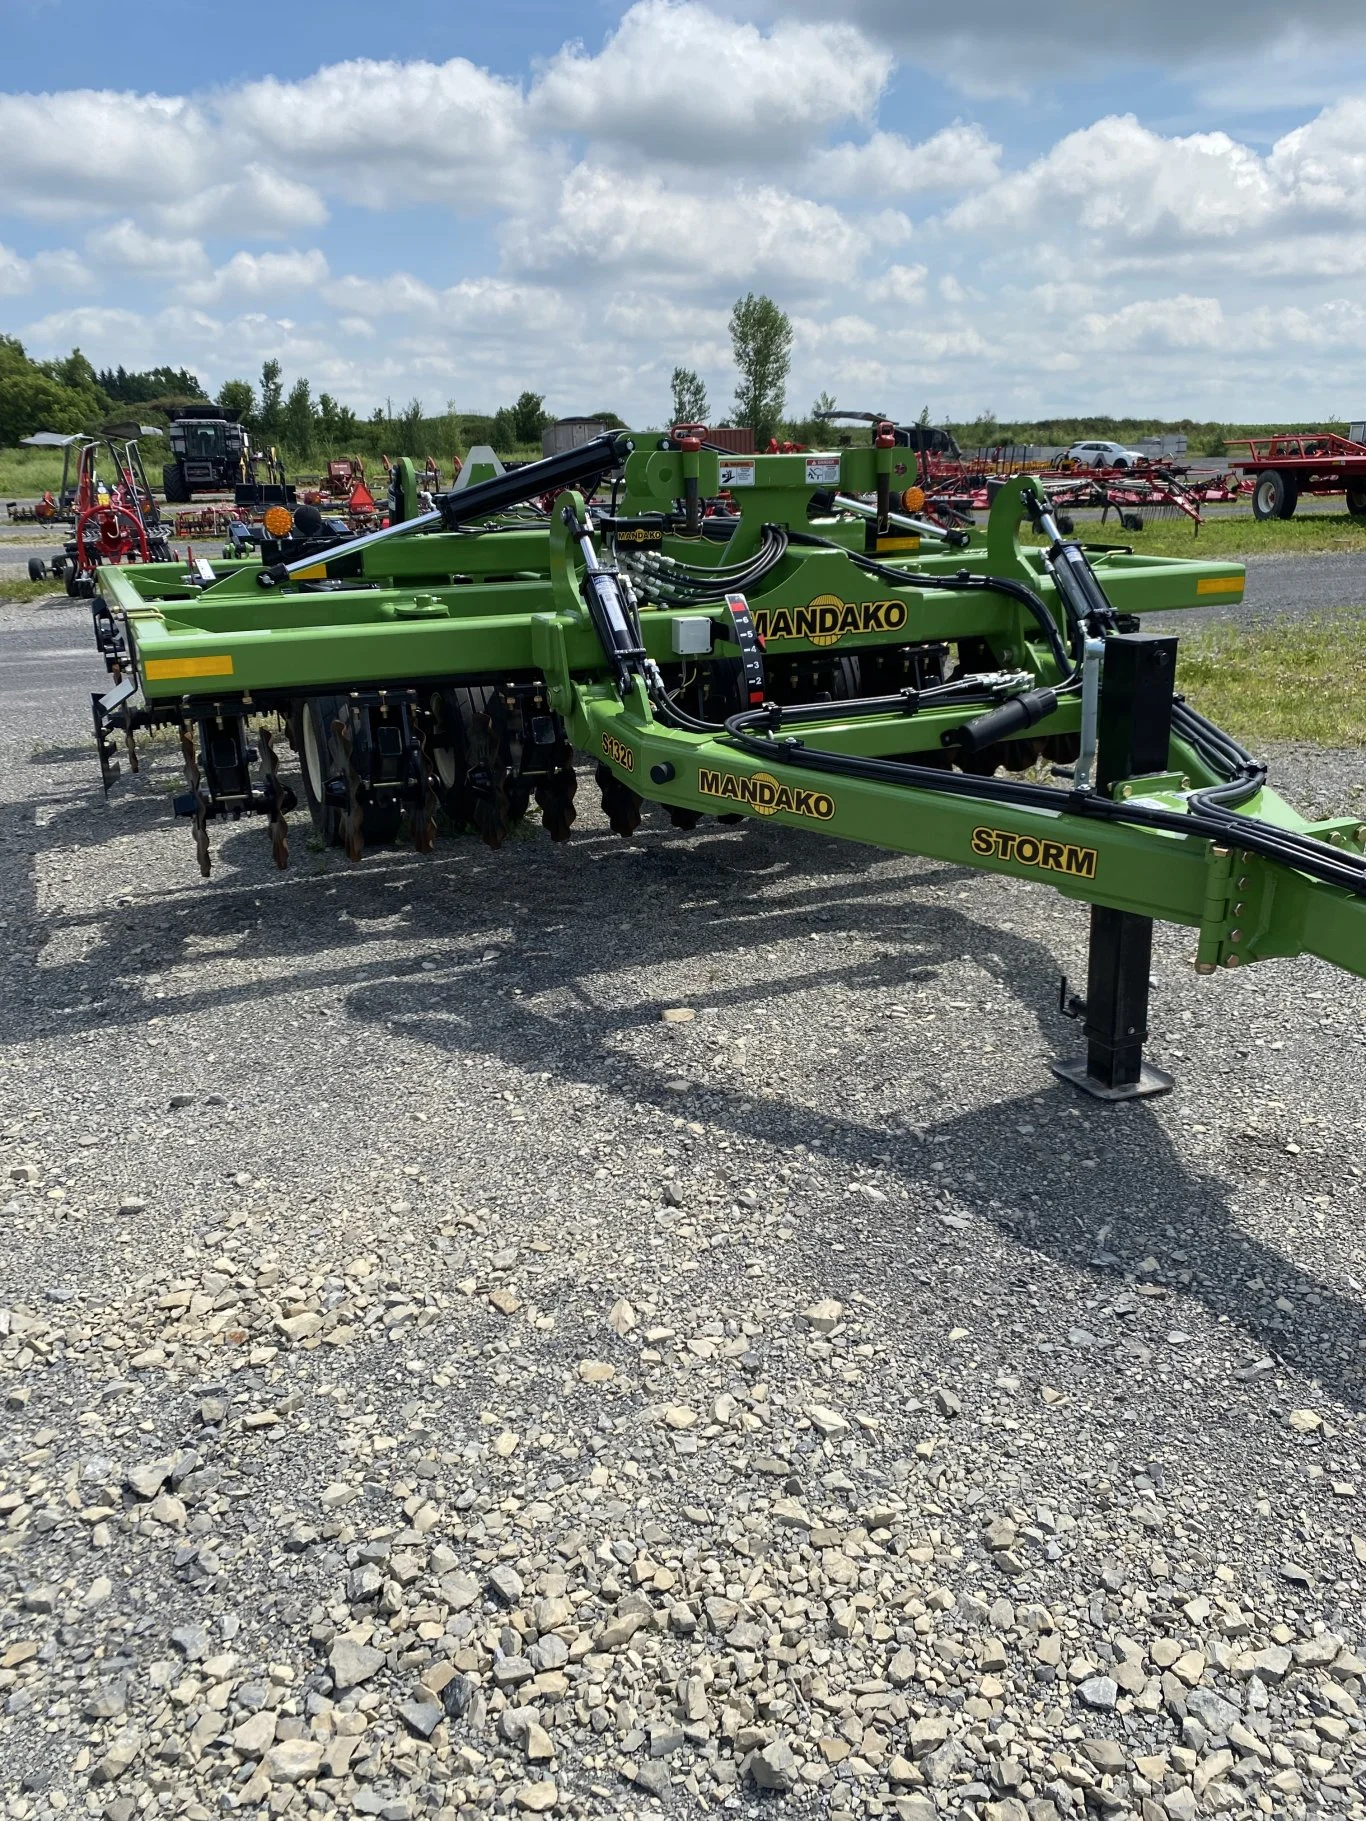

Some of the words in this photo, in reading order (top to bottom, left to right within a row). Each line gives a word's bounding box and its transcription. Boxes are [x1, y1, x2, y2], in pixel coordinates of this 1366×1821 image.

[617, 530, 662, 541] MANDAKO
[742, 616, 749, 624] 6
[746, 630, 754, 638] 5
[750, 645, 757, 653] 4
[753, 661, 760, 669] 3
[755, 677, 762, 685] 2
[601, 732, 635, 773] S1320
[698, 768, 836, 821] MANDAKO
[971, 826, 1098, 879] STORM
